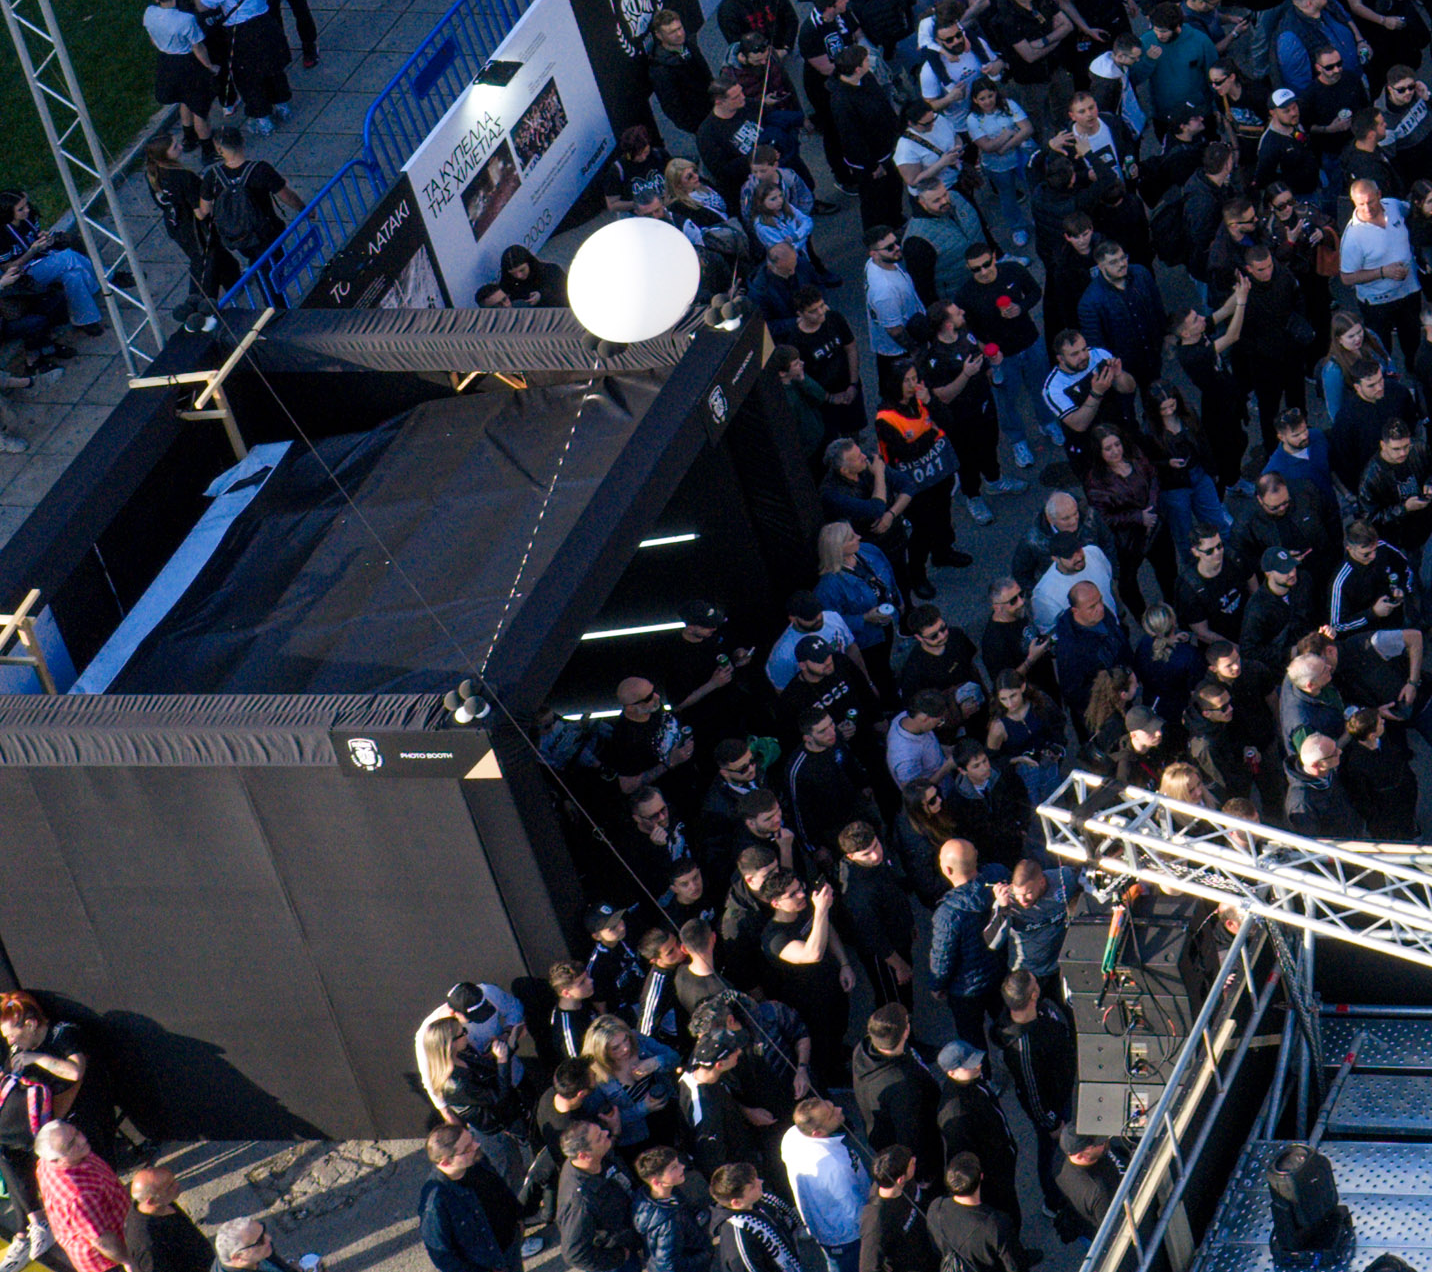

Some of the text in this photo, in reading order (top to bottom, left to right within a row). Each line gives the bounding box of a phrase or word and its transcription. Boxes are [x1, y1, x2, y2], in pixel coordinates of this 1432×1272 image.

[422, 111, 493, 202] ΤΑ ΚΥΠΕΛΛΑ
[428, 116, 505, 219] ΤΗΣ ΧΙΛΙΕΤΙΑΣ
[581, 138, 608, 177] SUPERBET
[523, 207, 553, 251] 2003
[899, 438, 945, 471] STEWARD
[912, 456, 943, 482] 041
